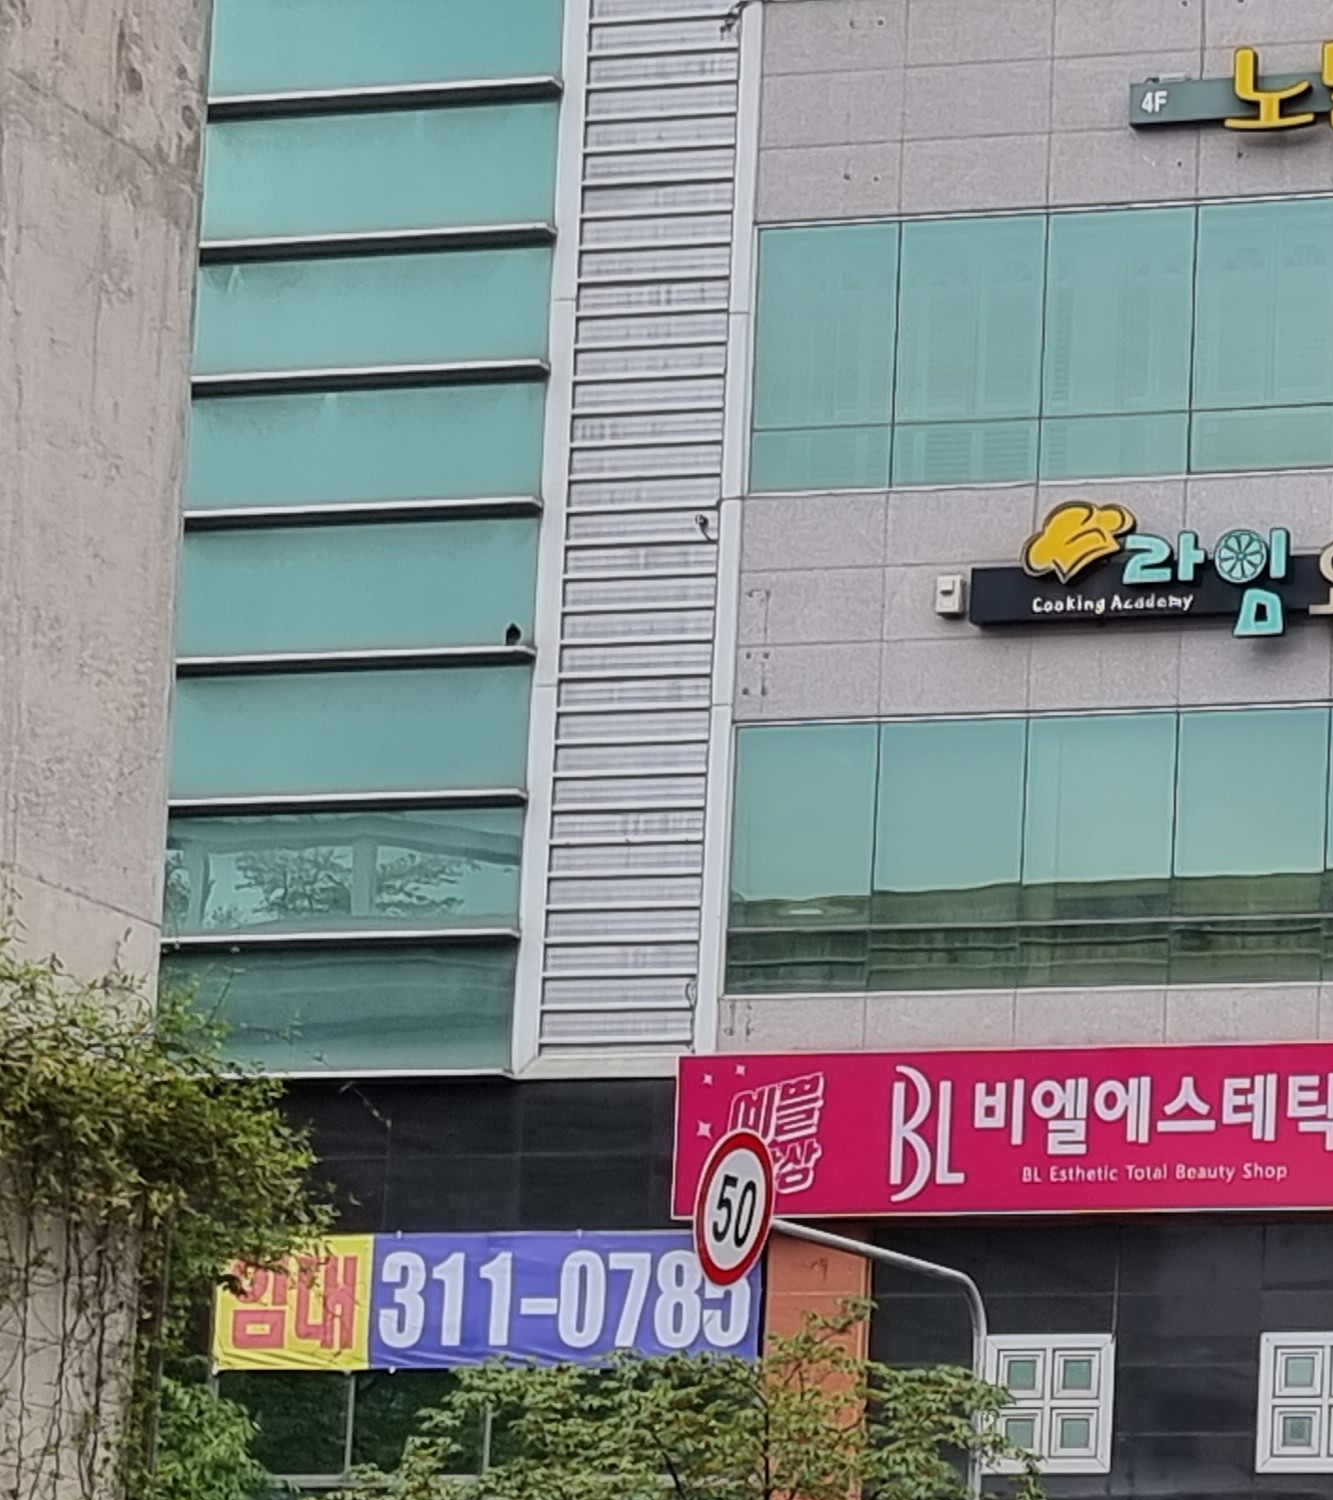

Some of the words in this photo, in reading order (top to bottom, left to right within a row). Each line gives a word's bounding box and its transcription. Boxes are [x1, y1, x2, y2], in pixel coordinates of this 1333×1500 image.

[1140, 88, 1168, 115] 4F
[1032, 595, 1105, 615] Cooking
[1110, 594, 1194, 612] Academy
[1123, 528, 1288, 637] 라임
[889, 1065, 965, 1202] BL
[1022, 1166, 1044, 1183] BL
[1050, 1164, 1118, 1183] Esthetic
[1126, 1164, 1168, 1181] Total
[1176, 1163, 1236, 1185] Beauty
[1242, 1162, 1288, 1183] Shop
[712, 1174, 757, 1248] 50
[232, 1254, 358, 1349] 임대
[378, 1250, 751, 1349] 311-0785
